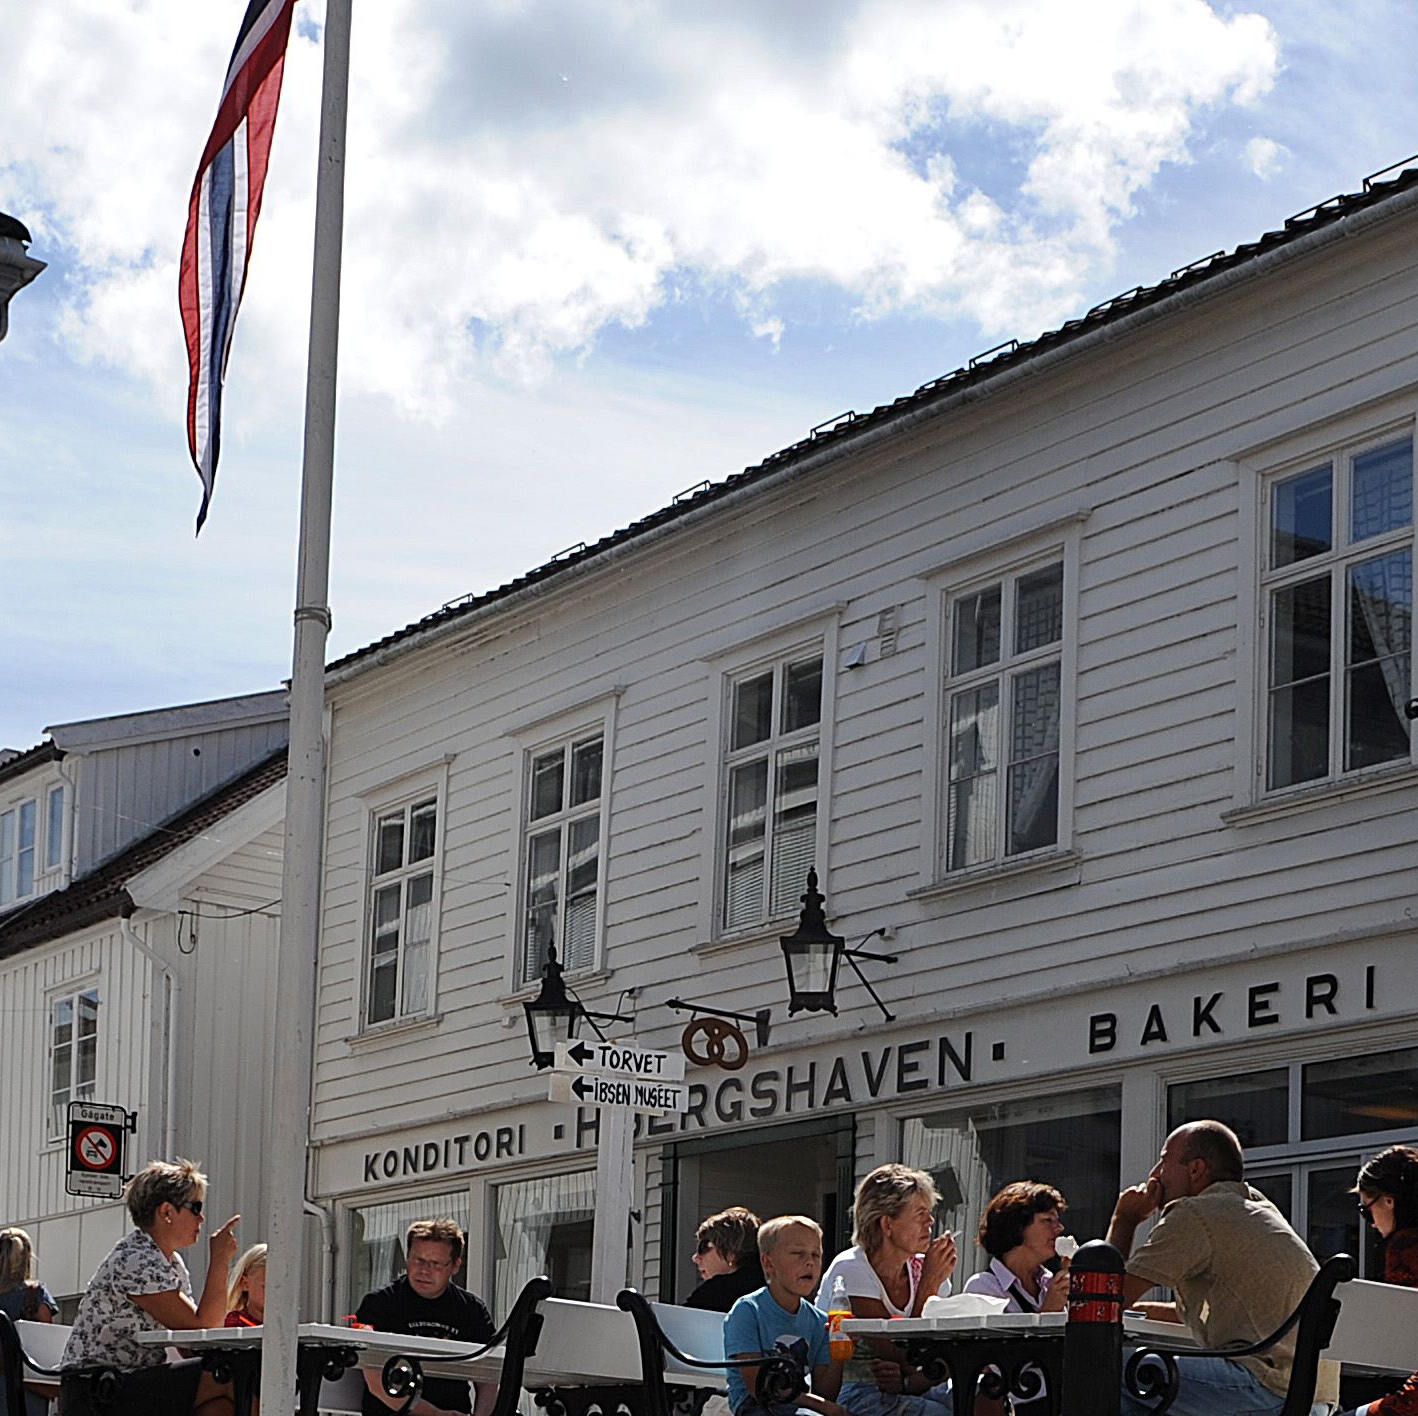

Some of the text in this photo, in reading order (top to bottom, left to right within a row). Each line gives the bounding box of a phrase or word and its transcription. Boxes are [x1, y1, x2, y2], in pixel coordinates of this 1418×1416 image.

[364, 1123, 525, 1182] KONDITORI
[1089, 965, 1375, 1054] BAKERI
[598, 1045, 667, 1074] TORVET
[81, 1109, 114, 1121] Gågate
